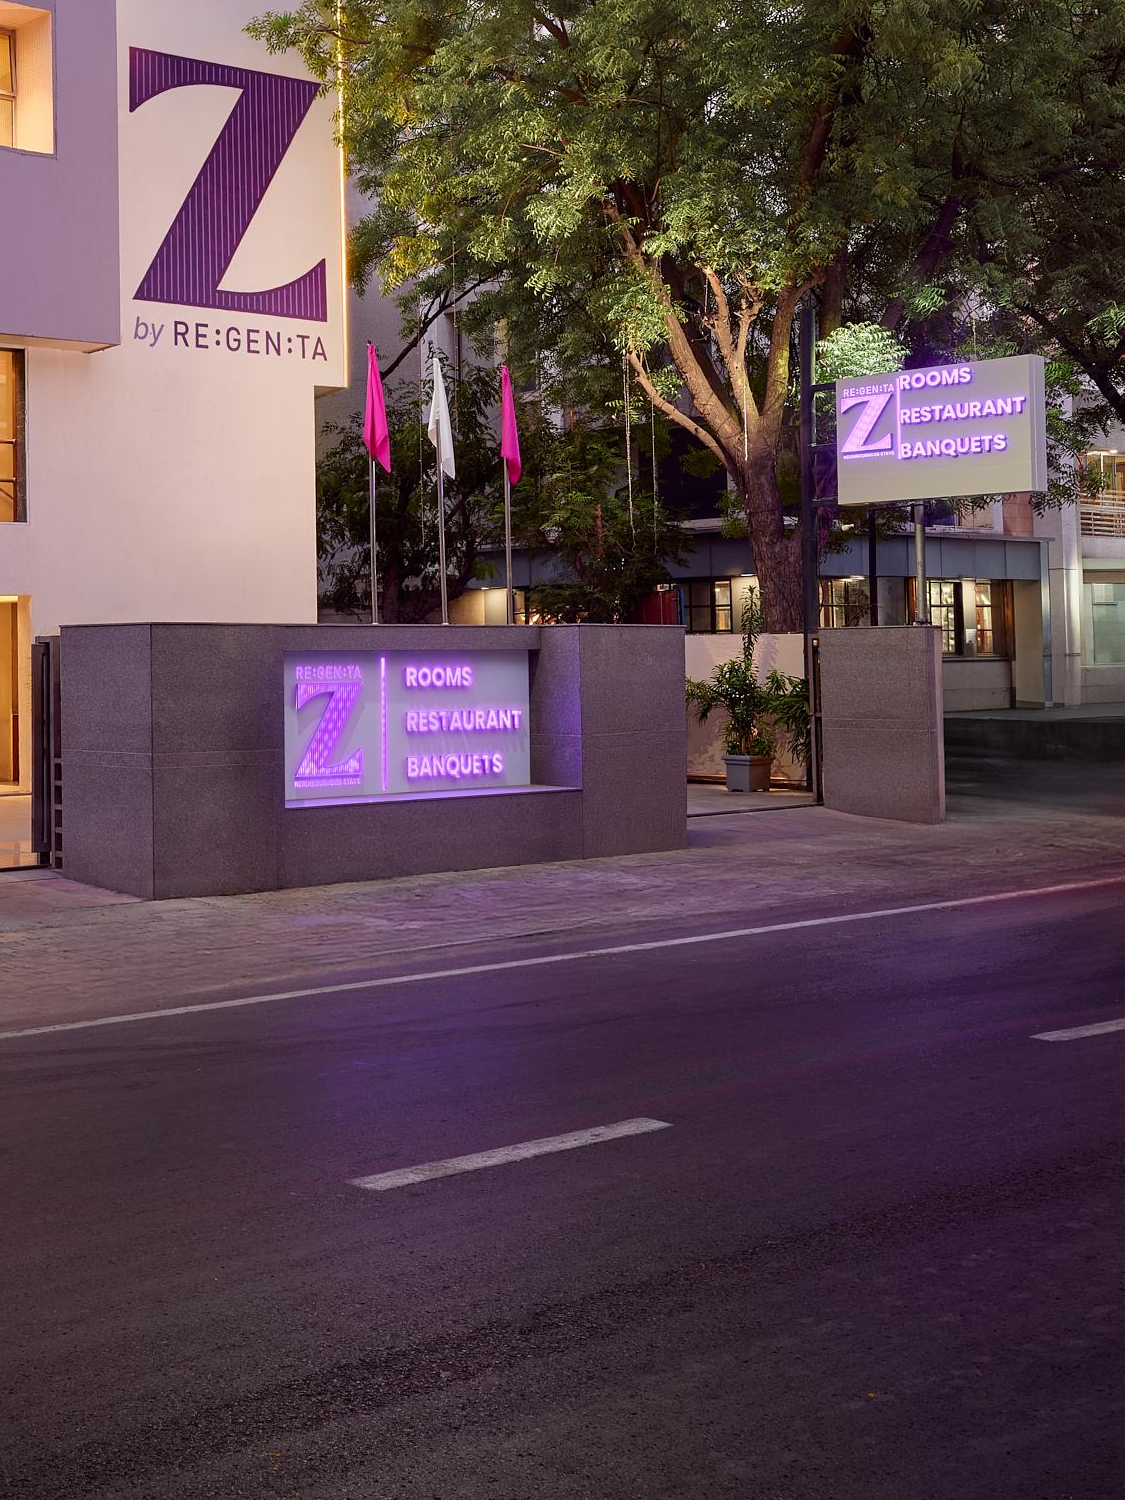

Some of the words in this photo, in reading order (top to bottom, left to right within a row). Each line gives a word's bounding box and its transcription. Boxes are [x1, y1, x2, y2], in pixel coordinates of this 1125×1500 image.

[129, 46, 327, 322] Z
[133, 316, 164, 346] by
[173, 321, 328, 361] RE:GEN:TA
[843, 384, 895, 397] RE:GEN:TA
[899, 367, 972, 390] ROOMS
[841, 392, 894, 453] Z
[900, 396, 1026, 424] RESTAURANT
[900, 434, 1007, 459] BANQUETS
[405, 665, 473, 687] ROOMS
[295, 682, 363, 778] Z
[405, 709, 522, 732] RESTAURANT
[406, 754, 504, 778] BANQUETS
